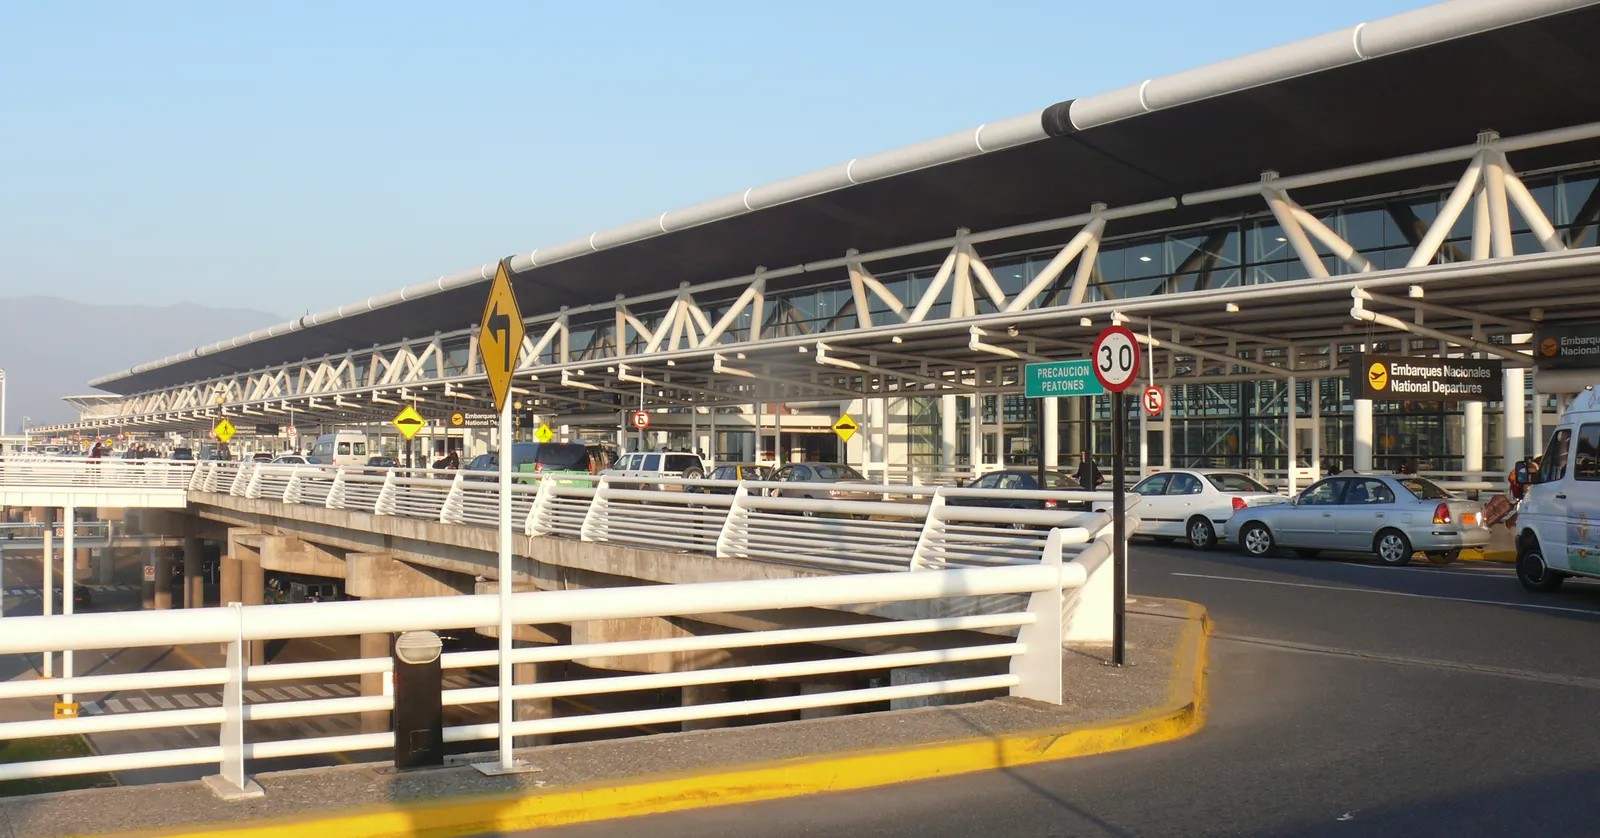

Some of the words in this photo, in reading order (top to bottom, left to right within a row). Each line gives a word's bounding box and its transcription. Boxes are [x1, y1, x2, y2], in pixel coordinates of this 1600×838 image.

[1100, 344, 1131, 372] 30
[1037, 366, 1089, 378] PRECAUCION
[1391, 363, 1442, 378] Embarques
[1443, 365, 1491, 378] Nacionales
[1042, 380, 1084, 391] PEATONES
[1391, 379, 1430, 392] National
[1432, 381, 1482, 395] Departures
